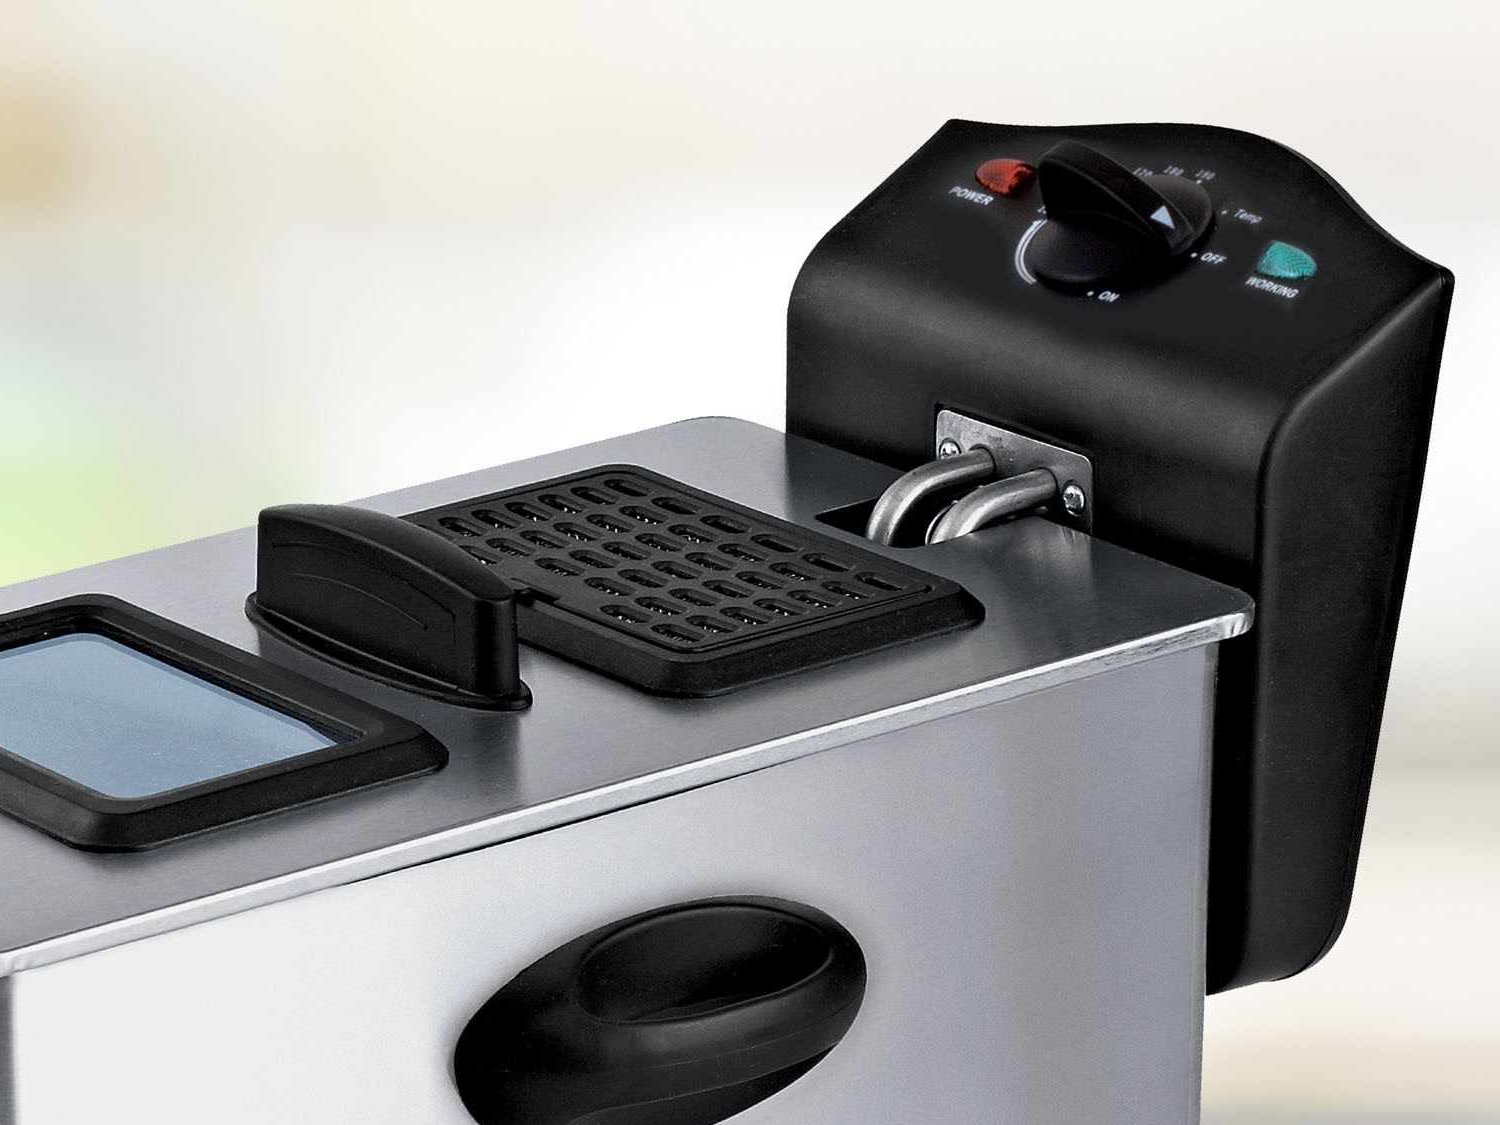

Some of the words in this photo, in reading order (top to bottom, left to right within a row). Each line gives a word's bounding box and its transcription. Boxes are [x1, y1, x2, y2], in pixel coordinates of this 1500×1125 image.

[949, 186, 994, 205] POWER
[1233, 208, 1263, 224] Temp
[1201, 252, 1227, 264] OFF
[1245, 276, 1299, 299] WORKING
[1098, 290, 1120, 302] ON
